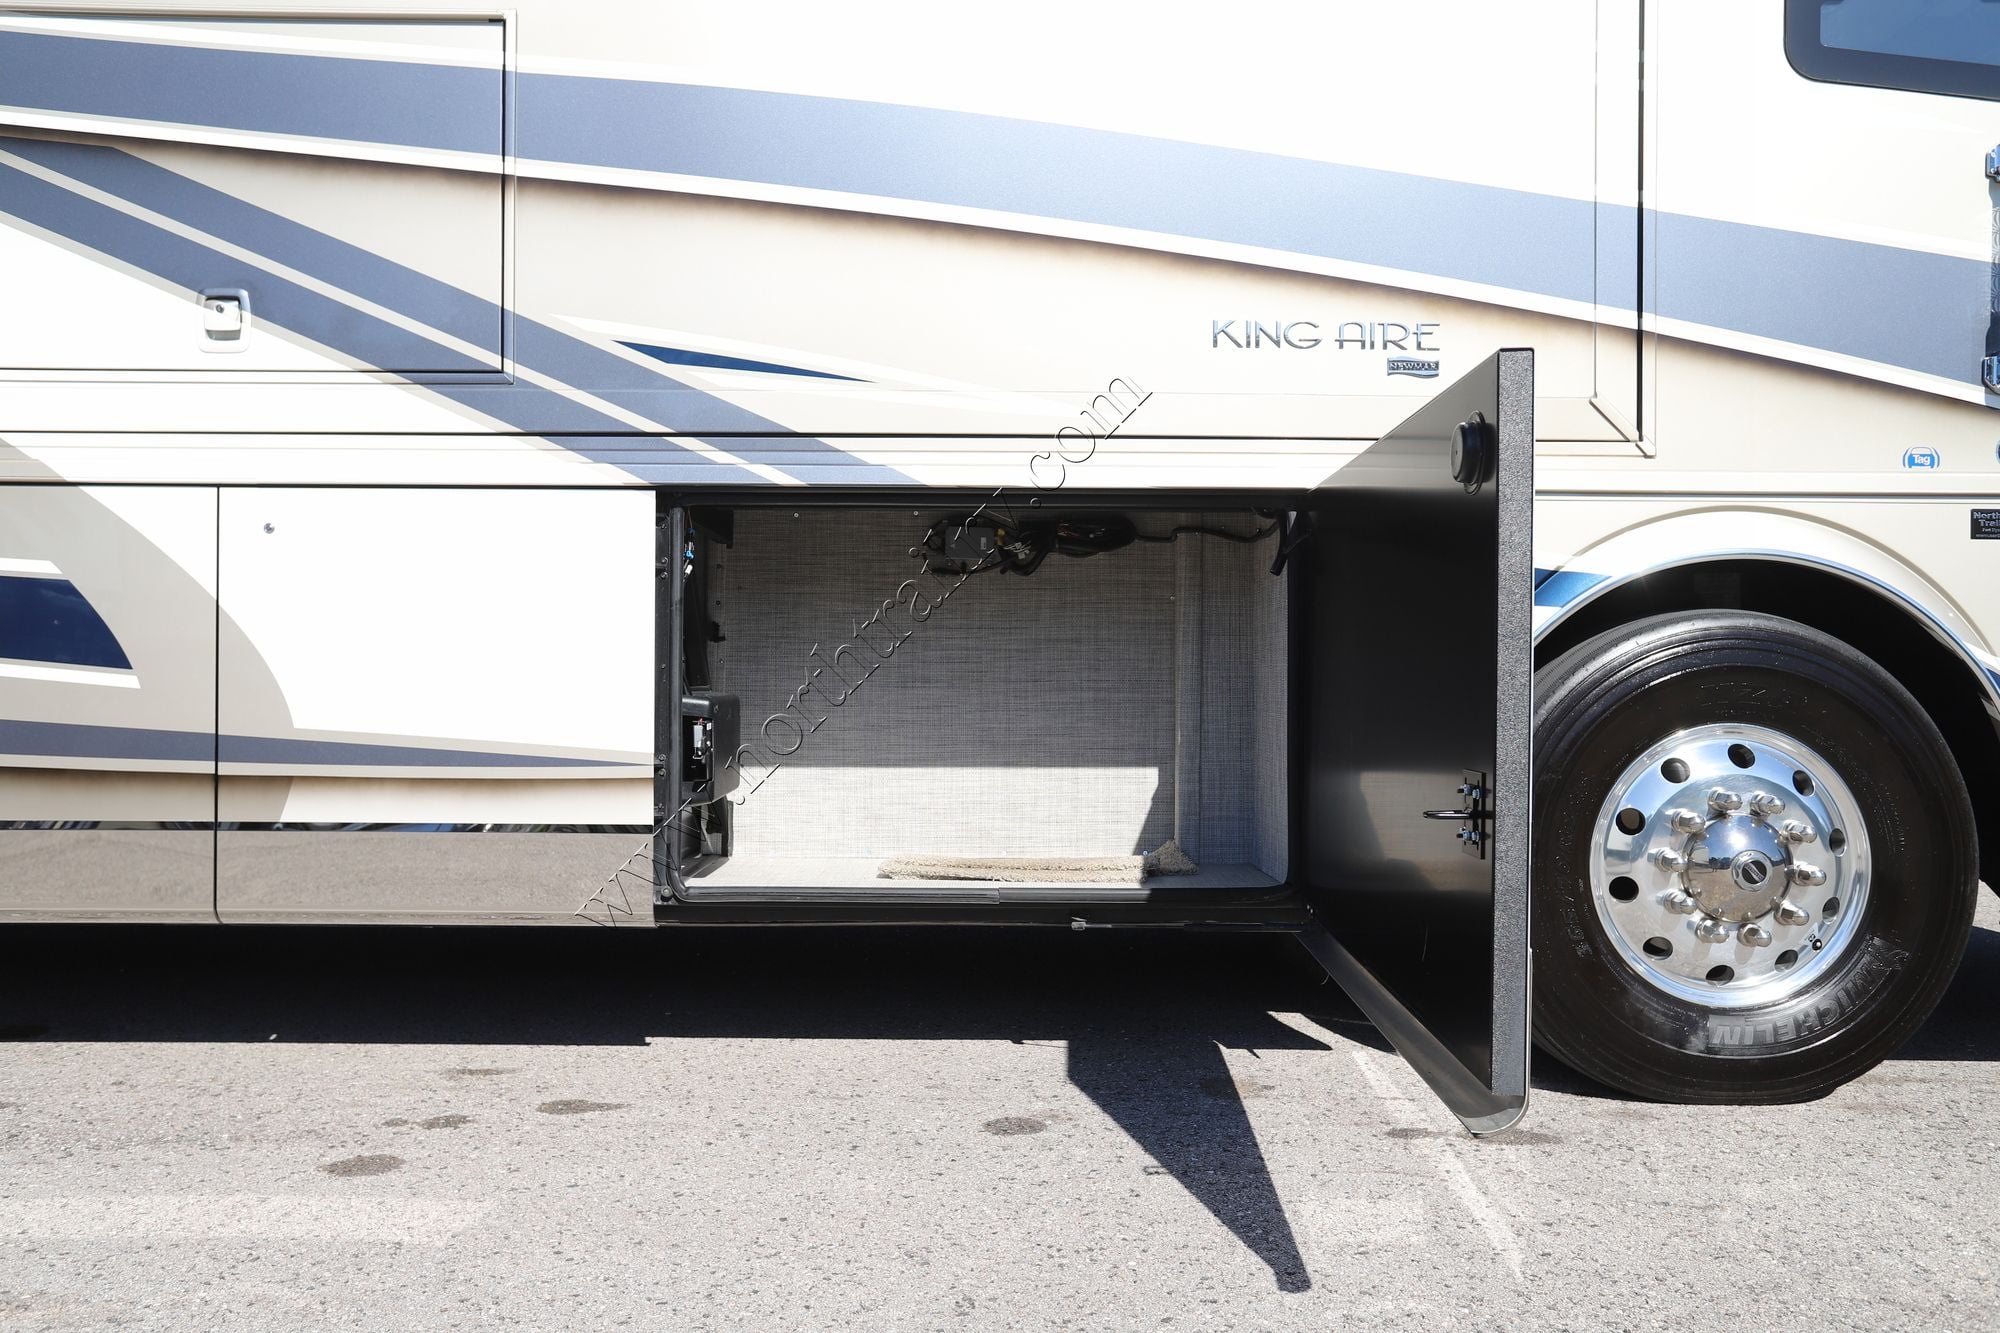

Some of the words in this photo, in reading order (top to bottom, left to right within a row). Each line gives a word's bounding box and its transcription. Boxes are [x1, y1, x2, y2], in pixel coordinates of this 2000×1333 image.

[1212, 319, 1323, 350] KING
[1334, 321, 1440, 351] AIRE
[1389, 361, 1438, 371] NEWMAR
[1912, 454, 1931, 465] Tag
[1711, 964, 1884, 1045] MICHELIN
